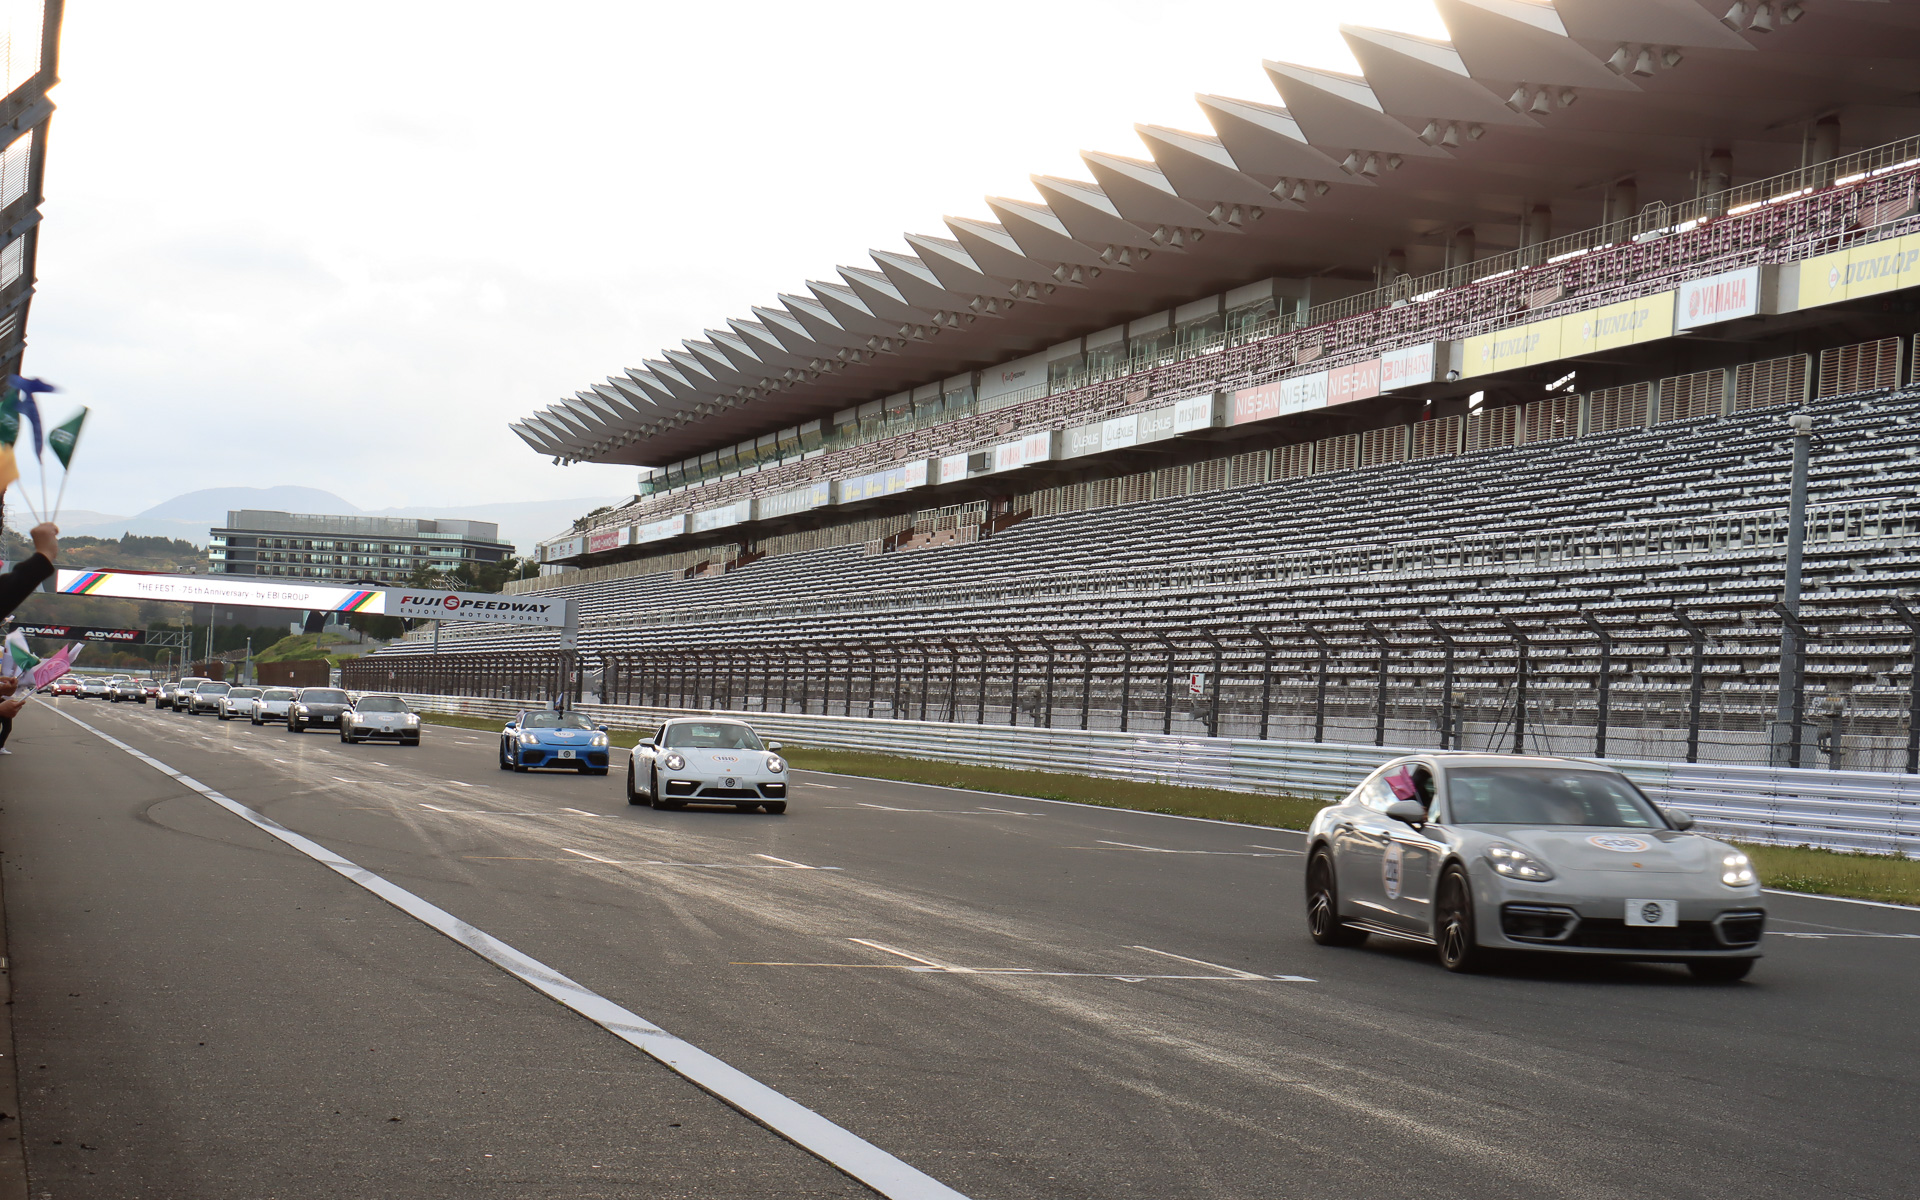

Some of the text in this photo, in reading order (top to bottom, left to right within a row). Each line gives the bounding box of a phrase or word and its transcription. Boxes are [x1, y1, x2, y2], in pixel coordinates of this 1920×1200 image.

[1841, 248, 1919, 286] DUNLOP
[1702, 278, 1747, 316] YAMAHA
[1591, 309, 1649, 338] DUNLOP
[1490, 333, 1540, 359] DUNLOP
[1393, 353, 1432, 379] DAIHATSU
[1281, 379, 1328, 406] NISSAN
[1329, 368, 1379, 396] NISSAN
[1235, 390, 1279, 416] NISSAN
[1113, 425, 1134, 440] LEXUS
[1149, 417, 1171, 433] LEXUS
[1078, 432, 1099, 447] LEXUS
[138, 583, 153, 591] THE
[204, 587, 249, 599] Anniversary
[256, 590, 265, 600] by
[267, 591, 280, 599] EBI
[282, 592, 310, 601] GROUP
[400, 607, 549, 622] ENJOY! MOTORSPORTS
[16, 626, 65, 635] ADVAN
[84, 630, 134, 640] ADVAN
